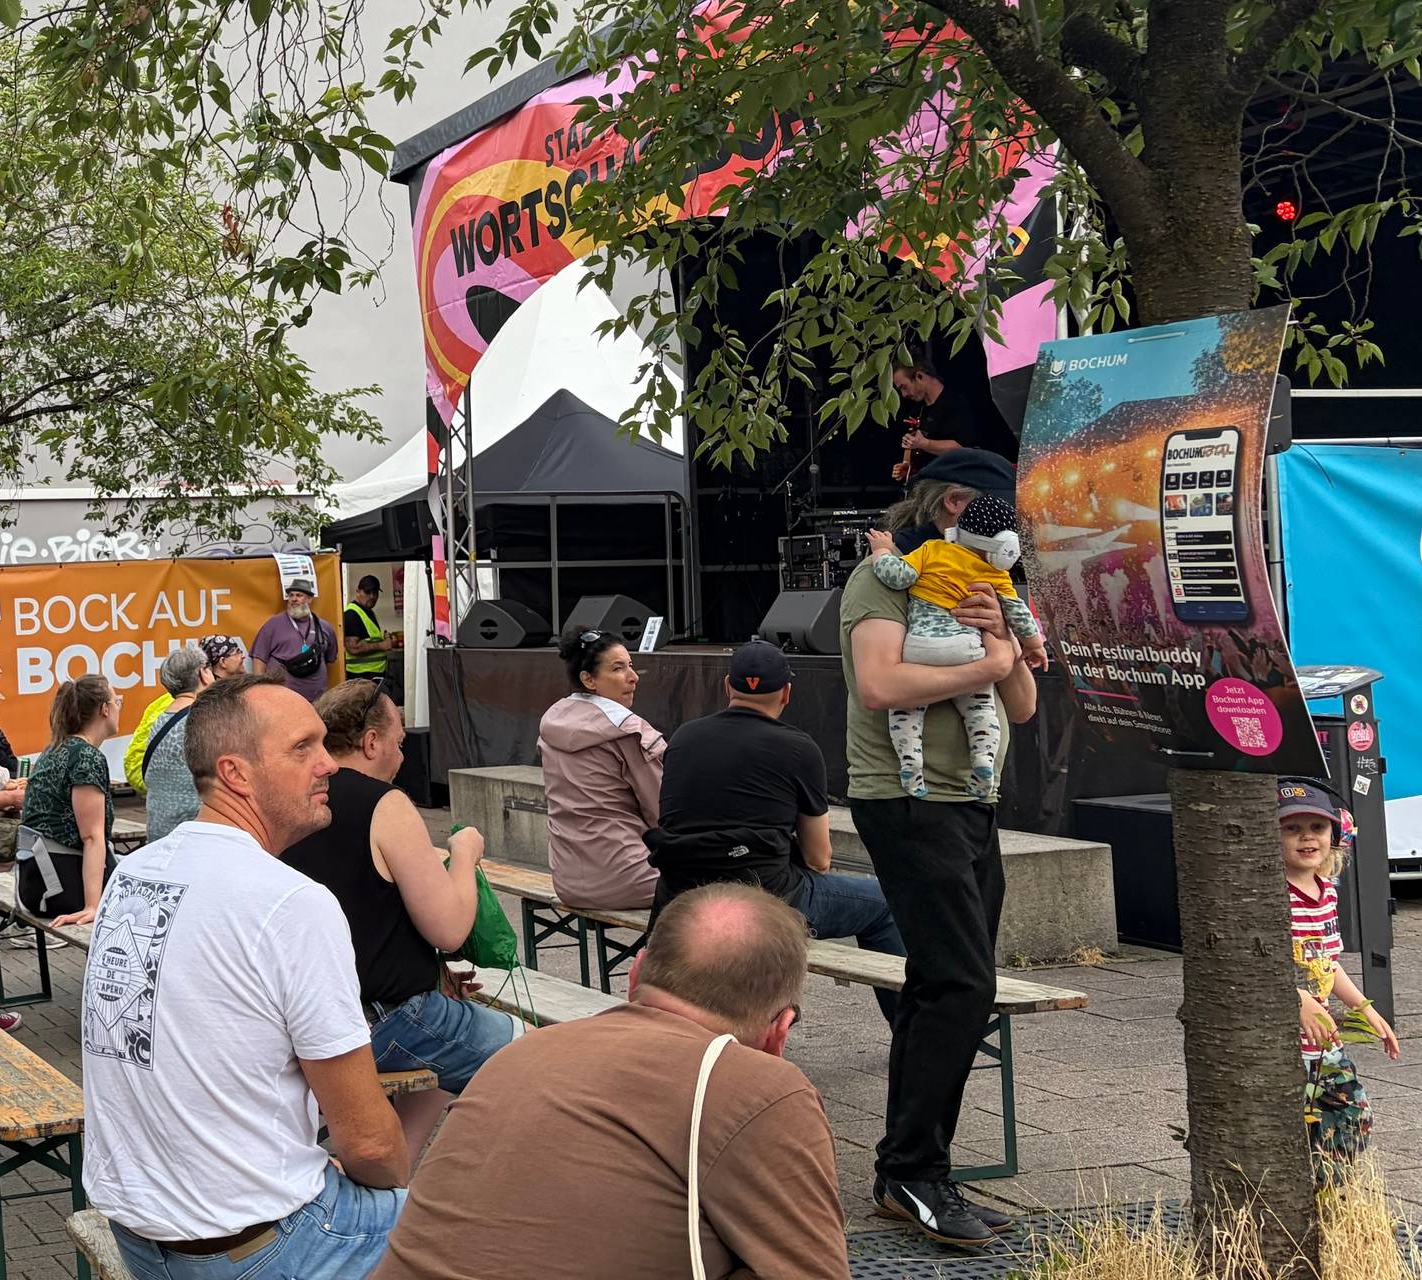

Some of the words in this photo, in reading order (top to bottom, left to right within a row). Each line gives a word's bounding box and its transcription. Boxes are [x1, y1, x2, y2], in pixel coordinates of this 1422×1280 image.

[1068, 353, 1128, 372] BOCHUM
[13, 592, 139, 636] BOCK
[147, 588, 232, 629] AUF
[1060, 641, 1092, 658] Dein
[1091, 642, 1202, 667] Festivalbuddy
[16, 636, 253, 695] BOCH
[1067, 660, 1082, 676] in
[1083, 662, 1104, 679] der
[1106, 665, 1168, 685] Bochum
[1171, 670, 1206, 690] App
[1224, 685, 1246, 694] Jetzt
[1212, 695, 1247, 705] Bochum
[1248, 696, 1265, 706] App
[1217, 705, 1267, 715] downloaden
[118, 886, 159, 908] NOWADAYS
[106, 970, 116, 979] DE
